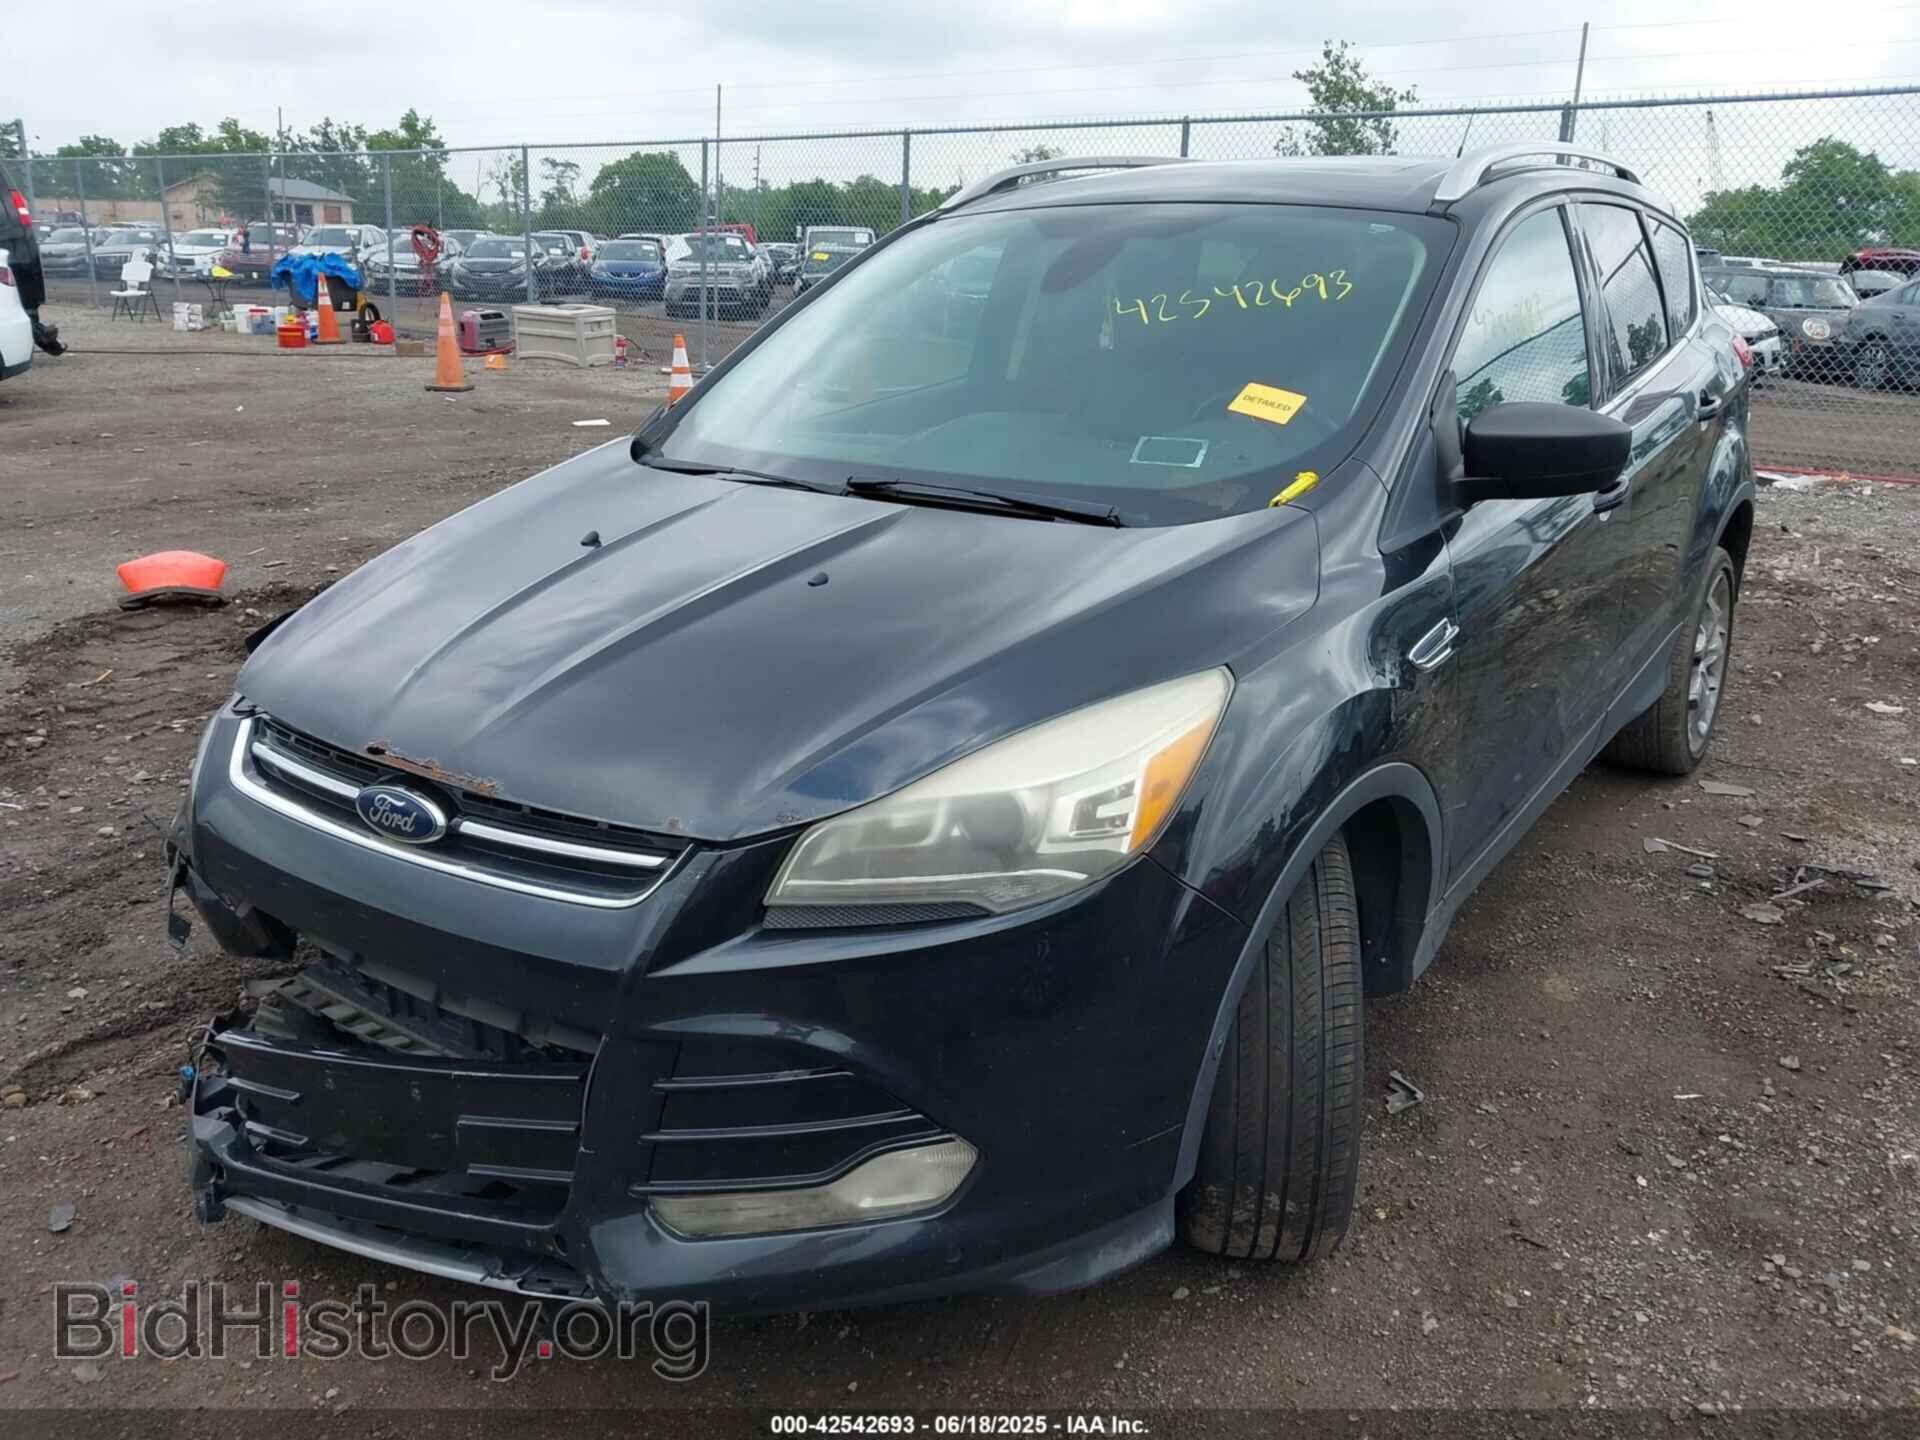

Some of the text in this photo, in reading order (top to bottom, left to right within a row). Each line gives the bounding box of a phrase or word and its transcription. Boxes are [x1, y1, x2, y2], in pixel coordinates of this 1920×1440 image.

[1112, 270, 1353, 325] 42542693
[1242, 394, 1291, 411] DETAILED
[368, 793, 417, 833] Ford
